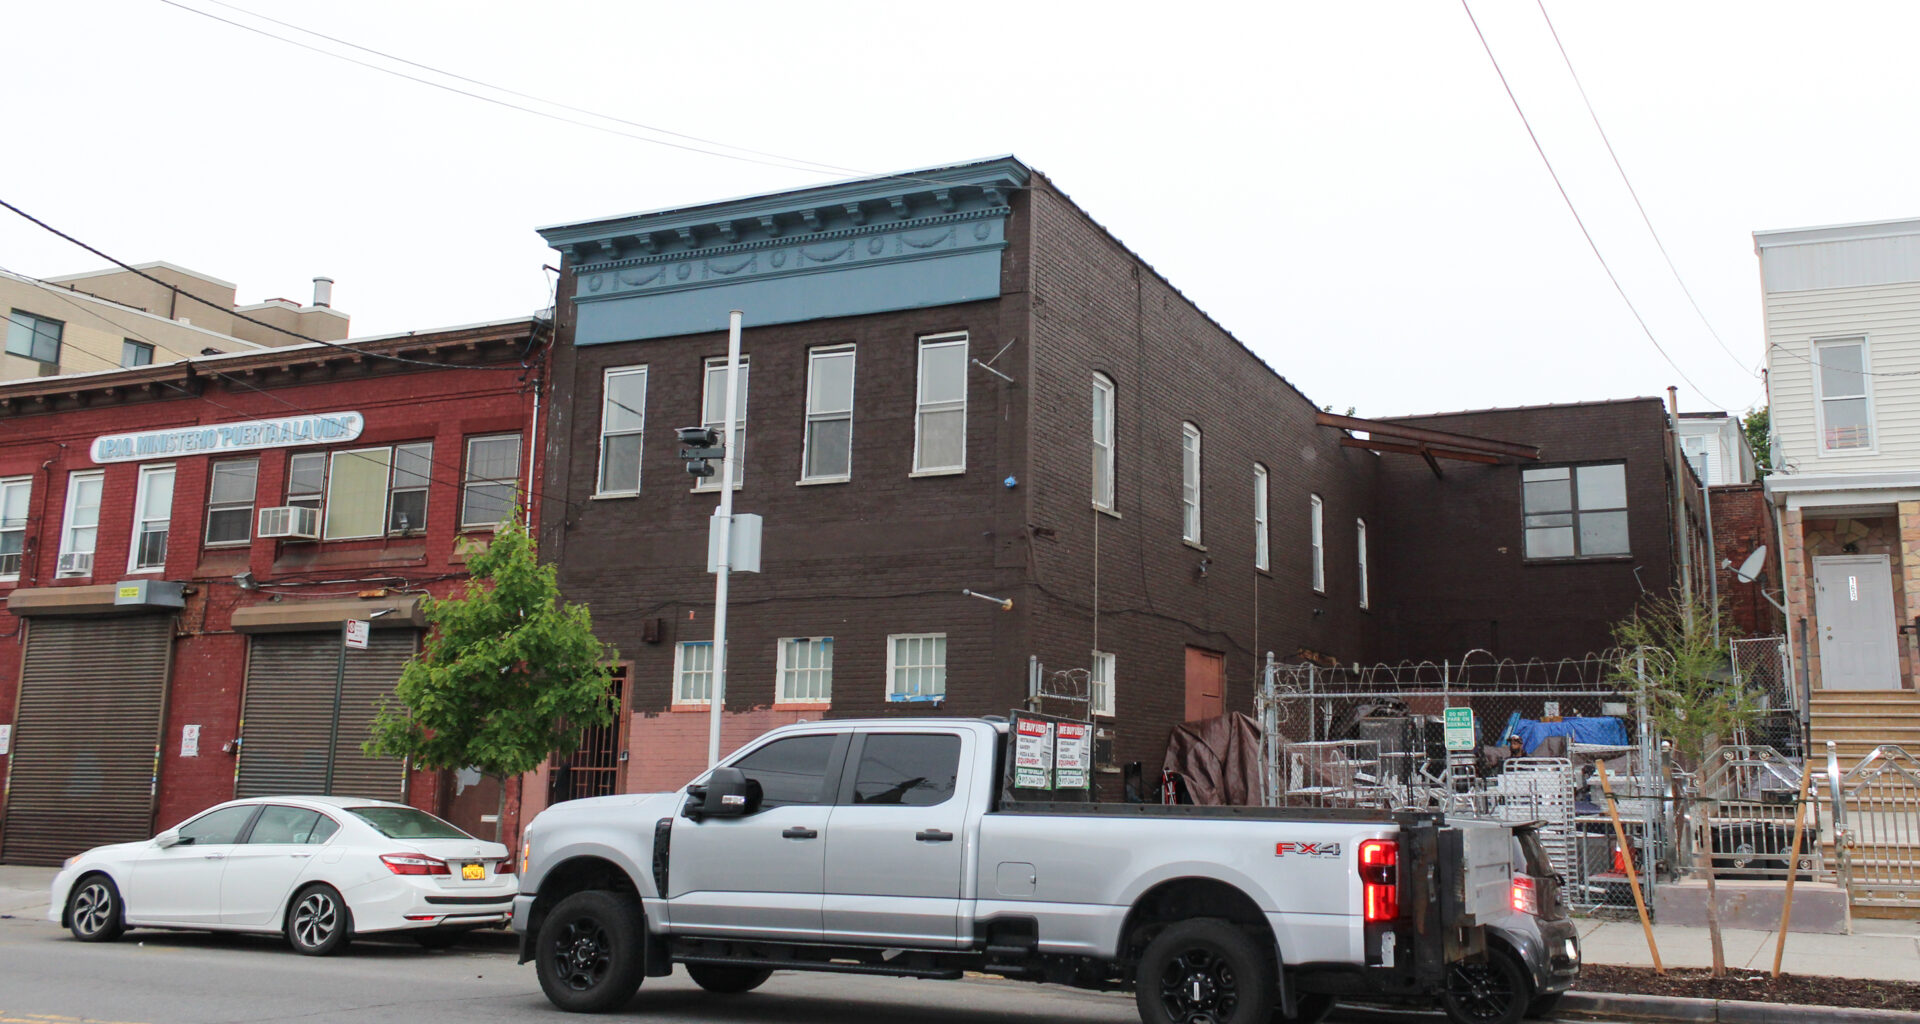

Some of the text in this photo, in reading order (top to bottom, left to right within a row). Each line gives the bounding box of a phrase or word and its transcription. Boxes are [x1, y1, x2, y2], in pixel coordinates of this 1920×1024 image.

[137, 429, 218, 455] MINISTERIO
[280, 422, 292, 442] A
[292, 420, 313, 441] LA
[1019, 721, 1046, 733] WE BUY USED
[1059, 725, 1084, 736] WE BUY USED
[1275, 841, 1341, 857] FX4
